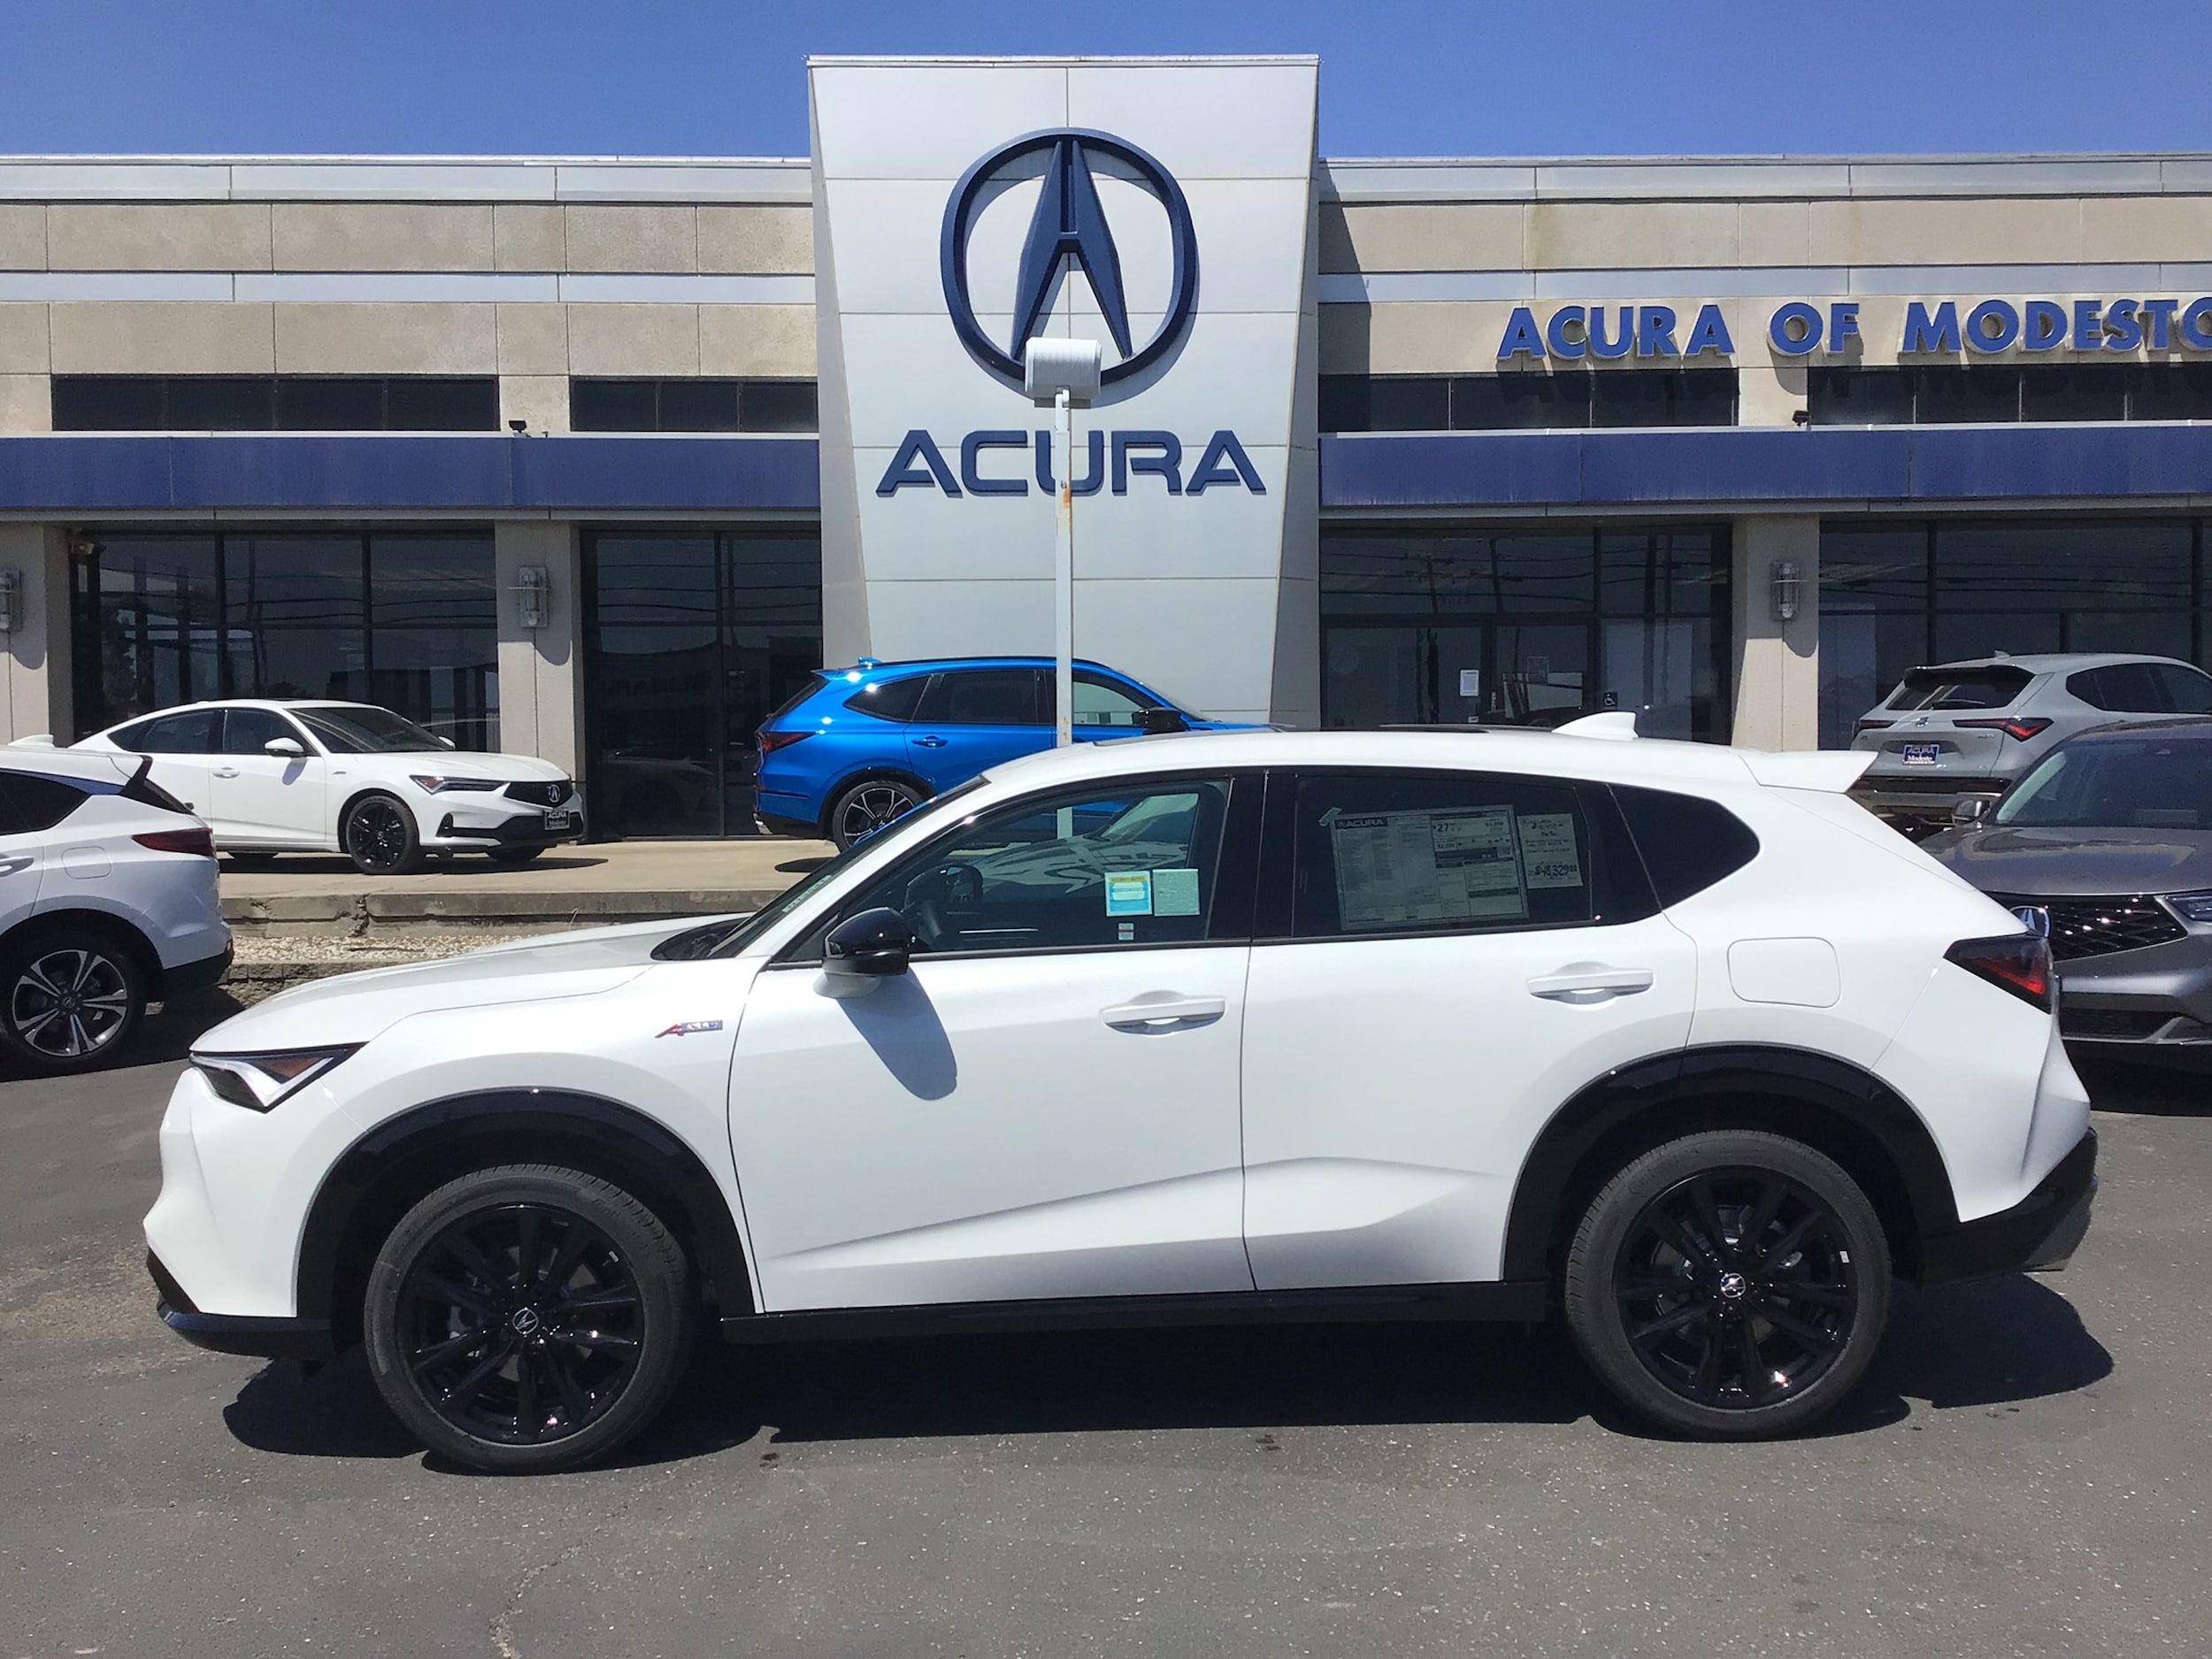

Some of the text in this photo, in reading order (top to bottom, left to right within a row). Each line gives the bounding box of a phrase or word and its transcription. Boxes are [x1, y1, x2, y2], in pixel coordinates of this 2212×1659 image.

[1496, 298, 2212, 360] ACURA OF MODESTO
[876, 430, 1266, 498] ACURA
[1345, 818, 1385, 827] ACURA
[1437, 823, 1449, 833] 27
